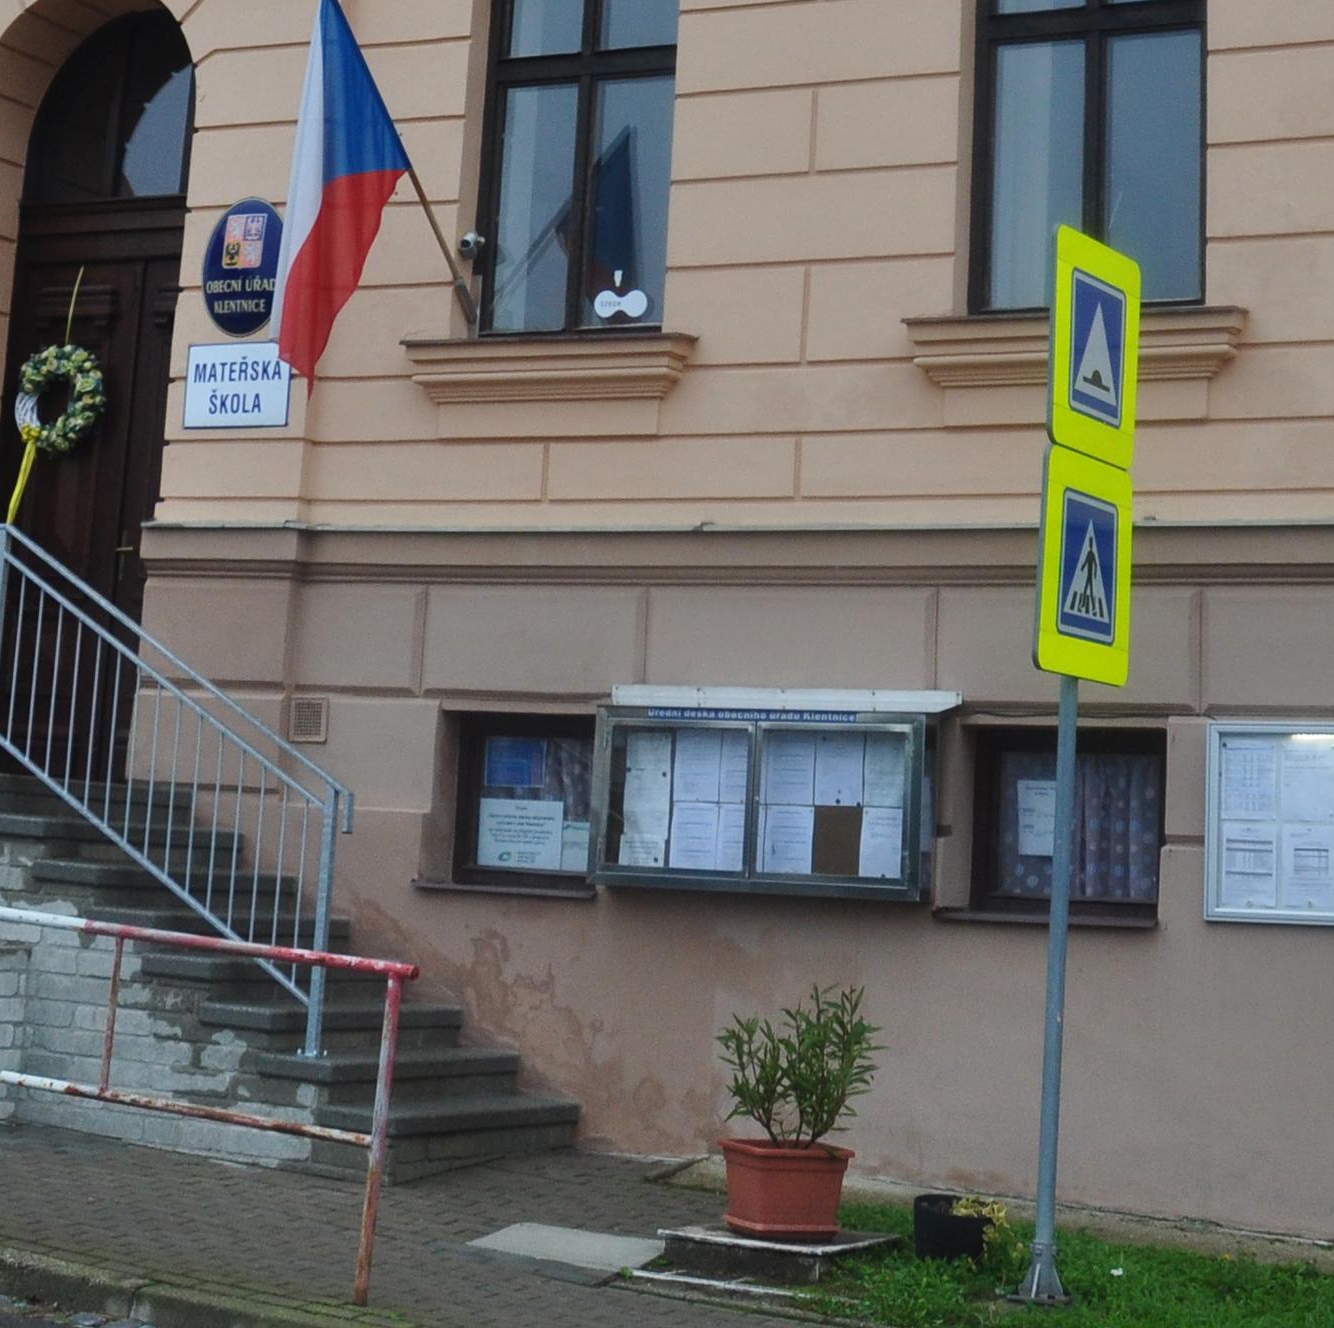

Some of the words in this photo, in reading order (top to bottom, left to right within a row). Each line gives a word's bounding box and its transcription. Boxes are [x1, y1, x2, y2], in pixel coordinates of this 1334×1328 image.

[206, 276, 242, 293] OBECNÍ
[214, 299, 266, 314] KLENTNICE
[208, 389, 261, 415] ŠKOLA
[803, 712, 855, 722] Klentnice
